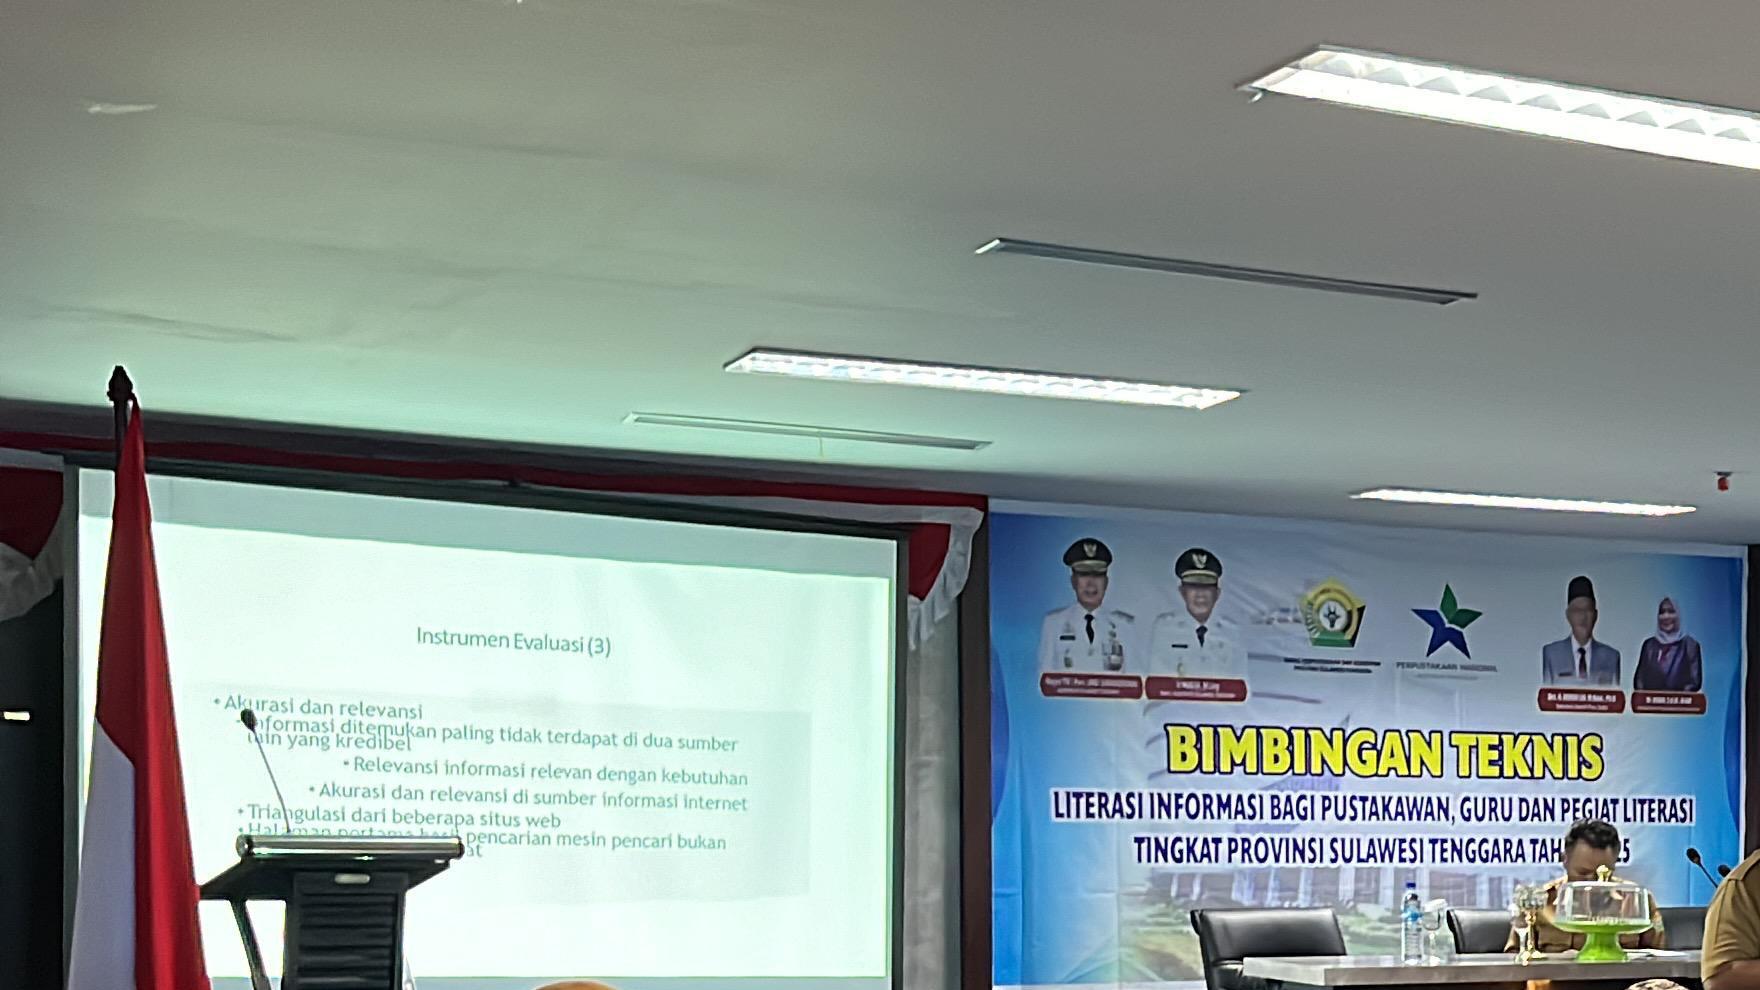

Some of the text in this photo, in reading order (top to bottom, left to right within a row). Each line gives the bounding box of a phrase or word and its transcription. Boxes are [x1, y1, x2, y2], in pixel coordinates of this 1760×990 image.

[416, 627, 612, 658] Instrumen Evaluasi (3)
[224, 695, 423, 719] Akurasi dan relevansi
[287, 734, 330, 751] yang
[336, 733, 412, 751] kredibel
[341, 719, 437, 740] ditemukan
[442, 725, 494, 744] paling
[500, 726, 542, 743] tidak
[547, 728, 618, 748] terdapat
[623, 732, 638, 747] di
[642, 733, 673, 748] dua
[678, 735, 738, 751] sumber
[1164, 724, 1605, 781] BIMBINGAN TEKNIS
[353, 757, 749, 786] Relevansi informasi relevan dengan kebutuhan
[319, 782, 748, 811] Akurasi dan relevansi di sumber informasi internet
[1053, 791, 1693, 825] LITERASI INFORMASI BAGI PUSTAKAWAN, GURU DAN PEGIAT LITERASI
[247, 803, 561, 828] Triangulasi dari beberapa situs web
[466, 830, 552, 849] pencarian
[557, 833, 607, 848] mesin
[611, 834, 673, 851] pencari
[677, 834, 727, 850] bukan
[1134, 837, 1562, 864] TINGKAT PROVINSI SULAWESI TENGGARA TAH
